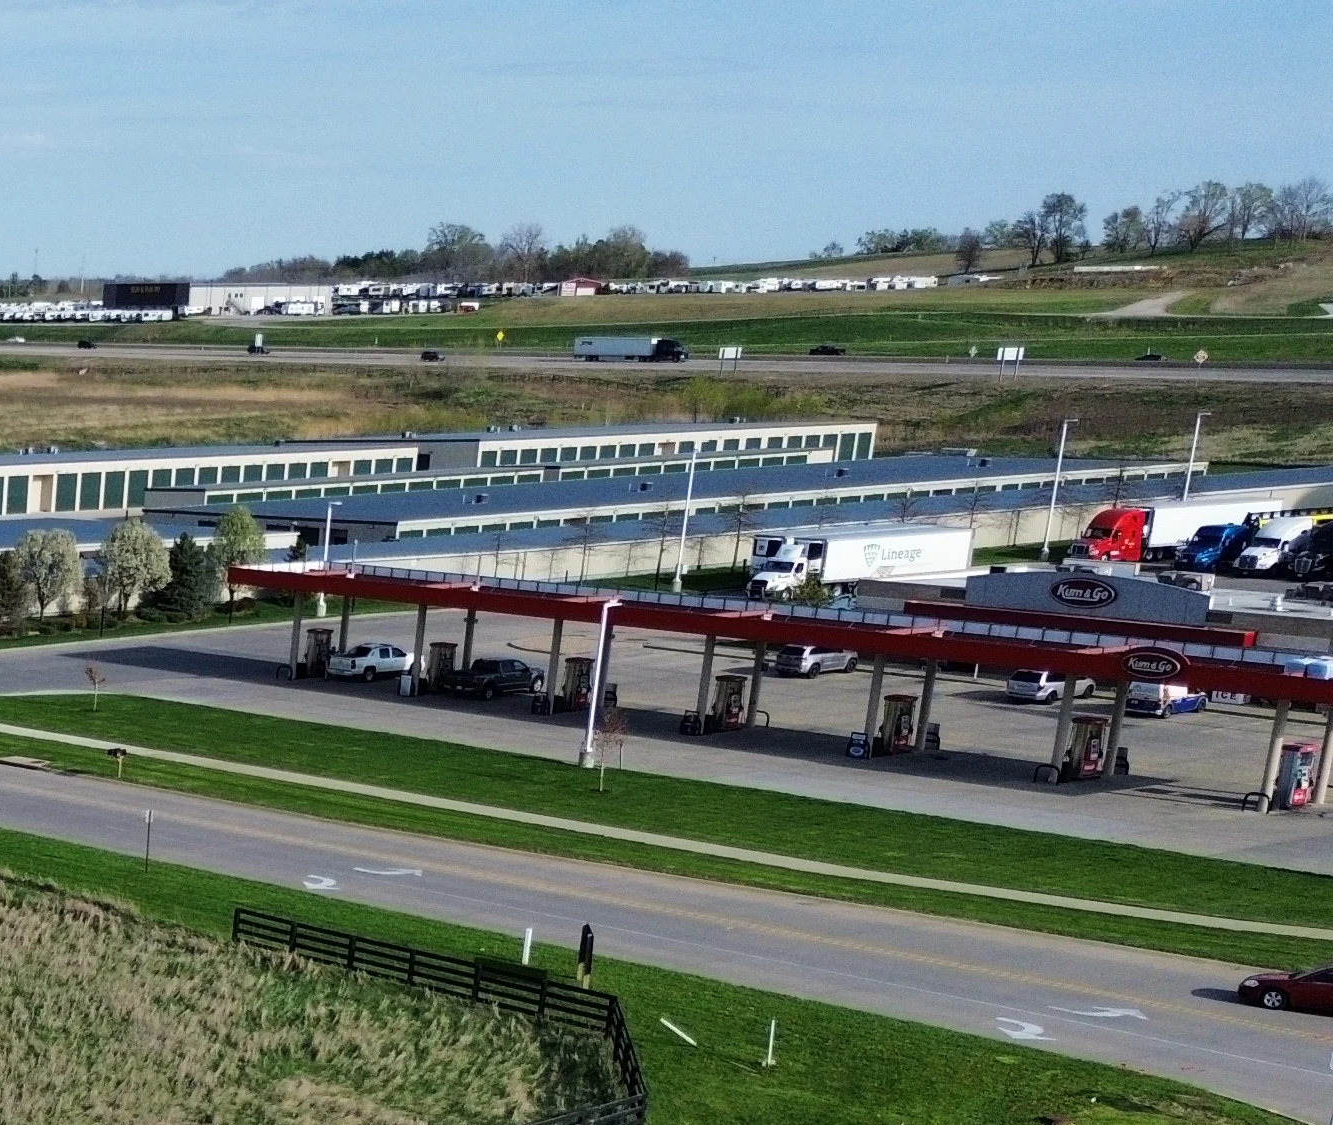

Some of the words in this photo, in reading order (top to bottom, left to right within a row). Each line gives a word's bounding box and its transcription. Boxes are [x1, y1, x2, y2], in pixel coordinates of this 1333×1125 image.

[881, 548, 922, 562] Lineage
[1056, 584, 1084, 599] Kum
[1084, 588, 1092, 598] &
[1093, 587, 1109, 601] Go
[1128, 657, 1151, 670] Kum
[1158, 660, 1173, 673] Go
[1215, 691, 1237, 701] ICE
